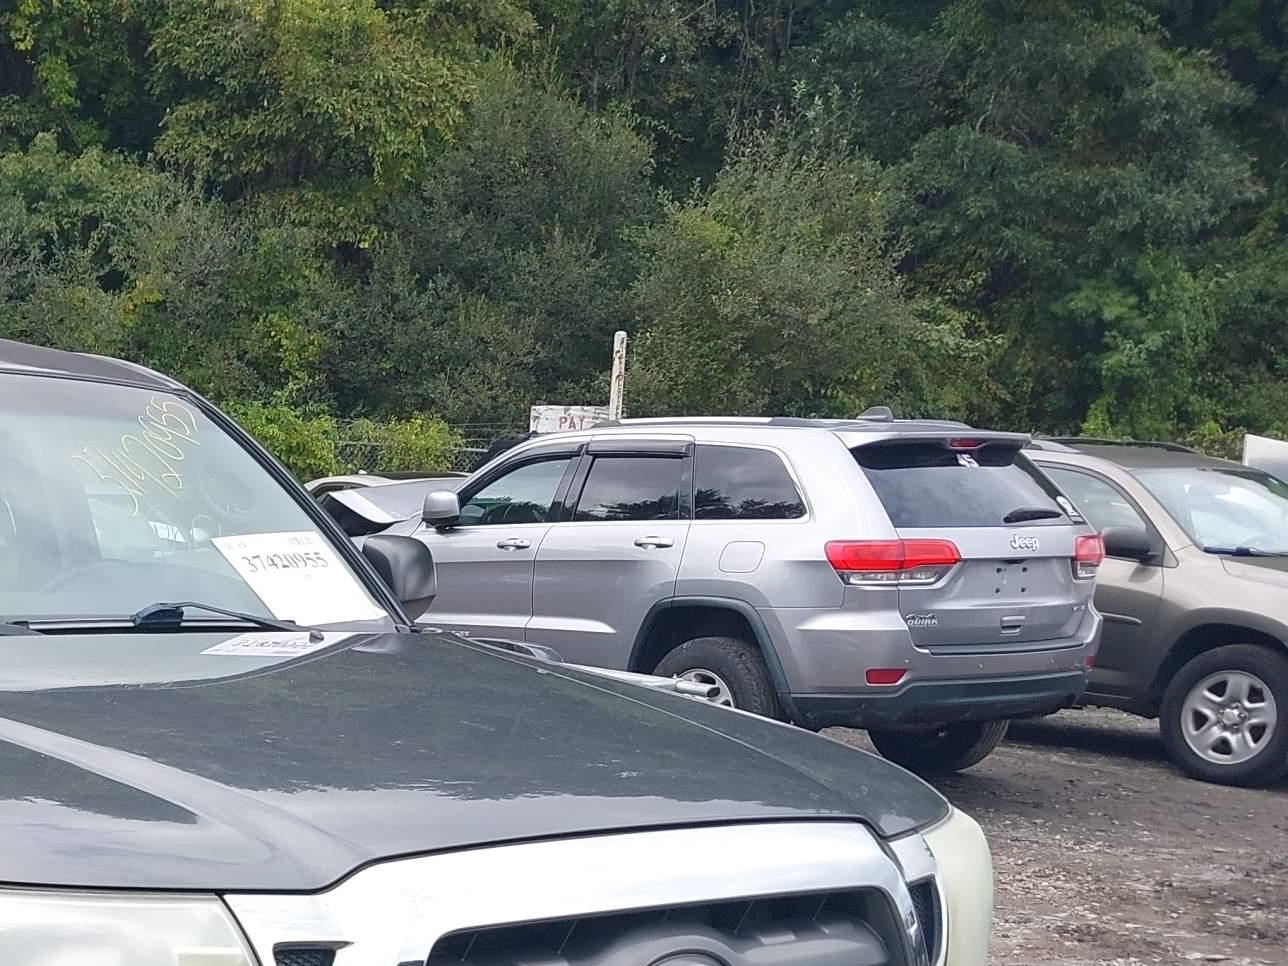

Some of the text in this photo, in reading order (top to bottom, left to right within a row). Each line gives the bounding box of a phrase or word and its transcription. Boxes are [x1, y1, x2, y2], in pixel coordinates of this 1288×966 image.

[559, 416, 585, 430] PAY
[1011, 534, 1039, 550] Jeep
[242, 551, 329, 573] 37420955
